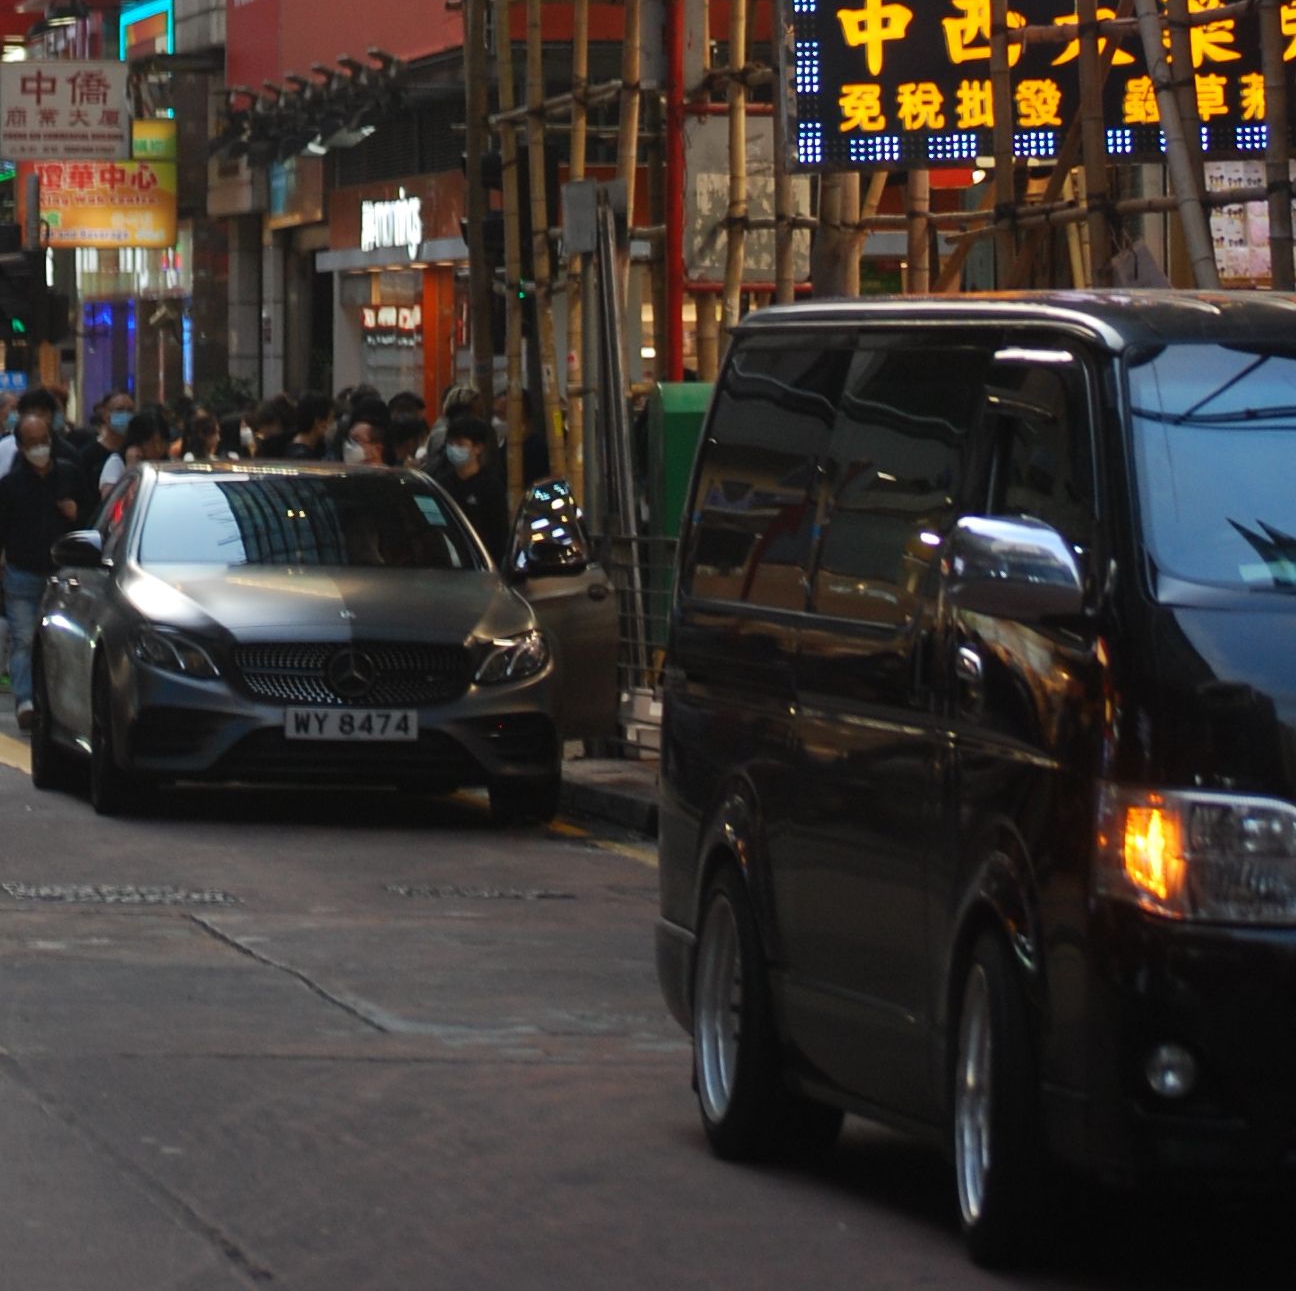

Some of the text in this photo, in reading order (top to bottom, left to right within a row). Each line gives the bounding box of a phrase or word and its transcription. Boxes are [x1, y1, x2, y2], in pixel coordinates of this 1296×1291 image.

[20, 69, 111, 106] 中僑
[293, 711, 410, 736] WY 8474
